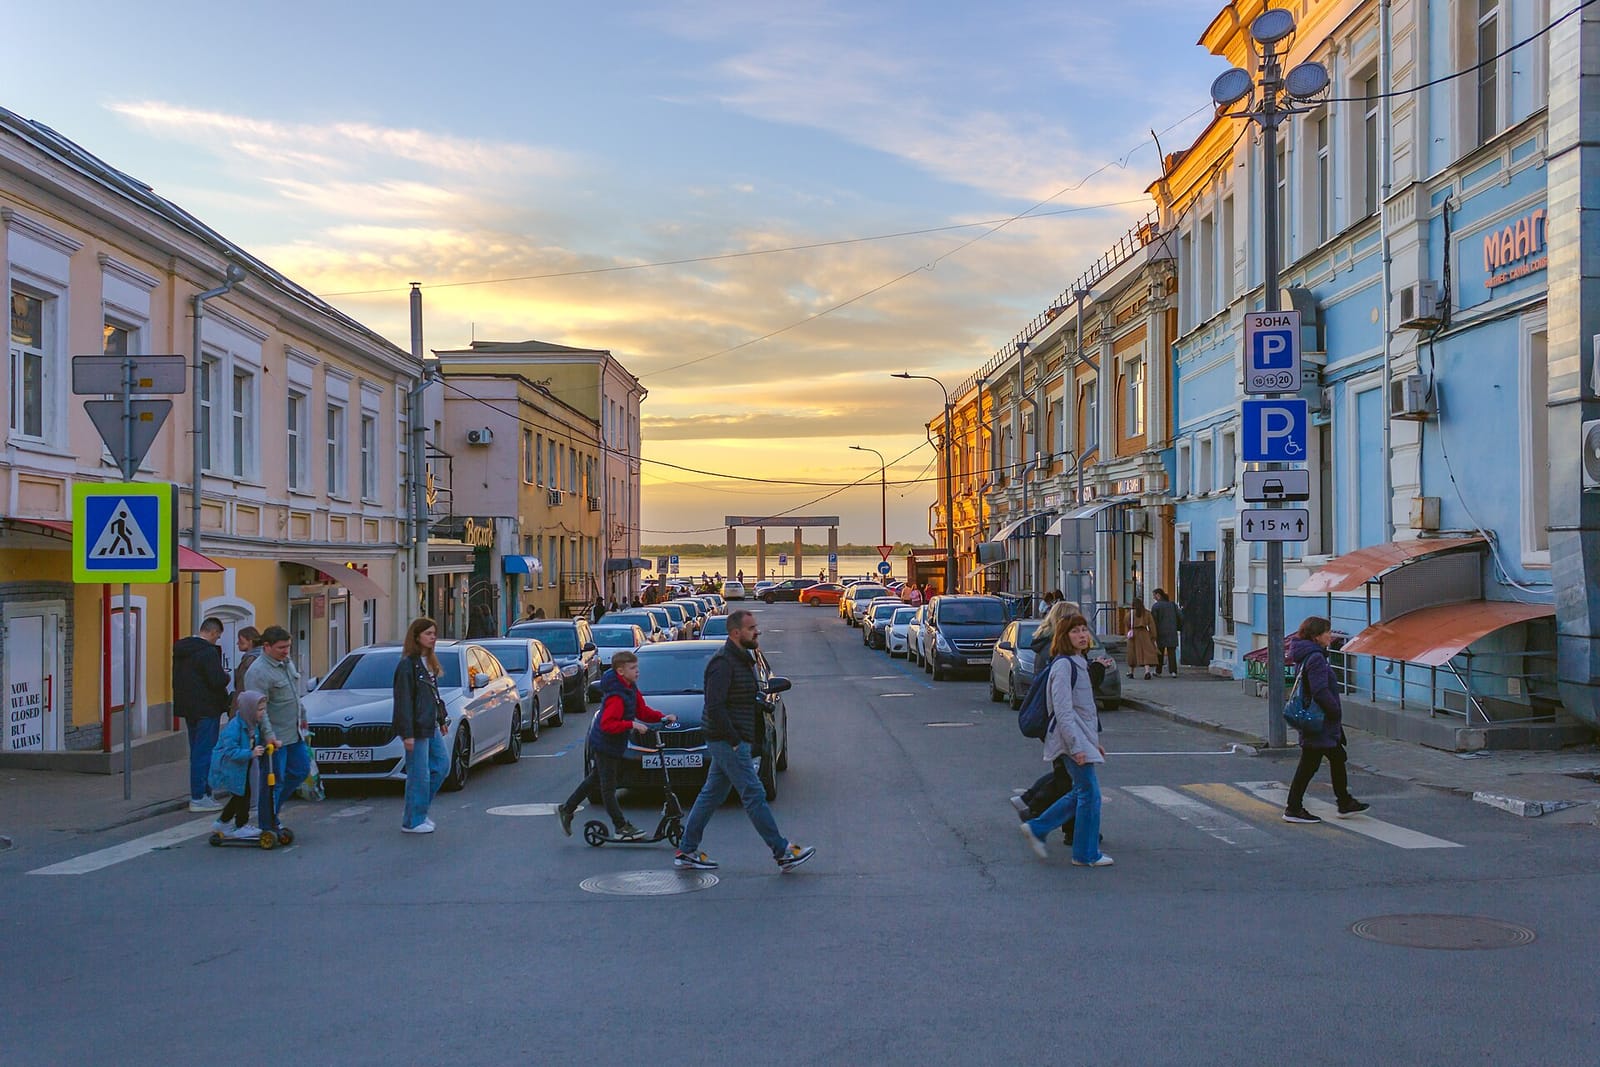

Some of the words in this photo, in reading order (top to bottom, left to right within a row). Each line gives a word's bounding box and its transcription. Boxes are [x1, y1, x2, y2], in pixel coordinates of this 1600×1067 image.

[1255, 316, 1291, 327] ЗОНА
[1262, 334, 1286, 365] P
[1266, 377, 1275, 385] 15
[1278, 375, 1289, 384] 20
[1260, 407, 1295, 455] P
[1260, 519, 1276, 531] 15
[11, 682, 28, 694] NOW
[11, 696, 24, 708] WE
[26, 693, 40, 706] ARE
[11, 708, 40, 722] CLOSED
[11, 723, 26, 737] BUT
[12, 733, 40, 749] ALWAYS
[319, 751, 354, 761] Н777ЕК
[356, 750, 369, 758] 152
[645, 756, 684, 767] Р43СК
[686, 755, 701, 764] 152
